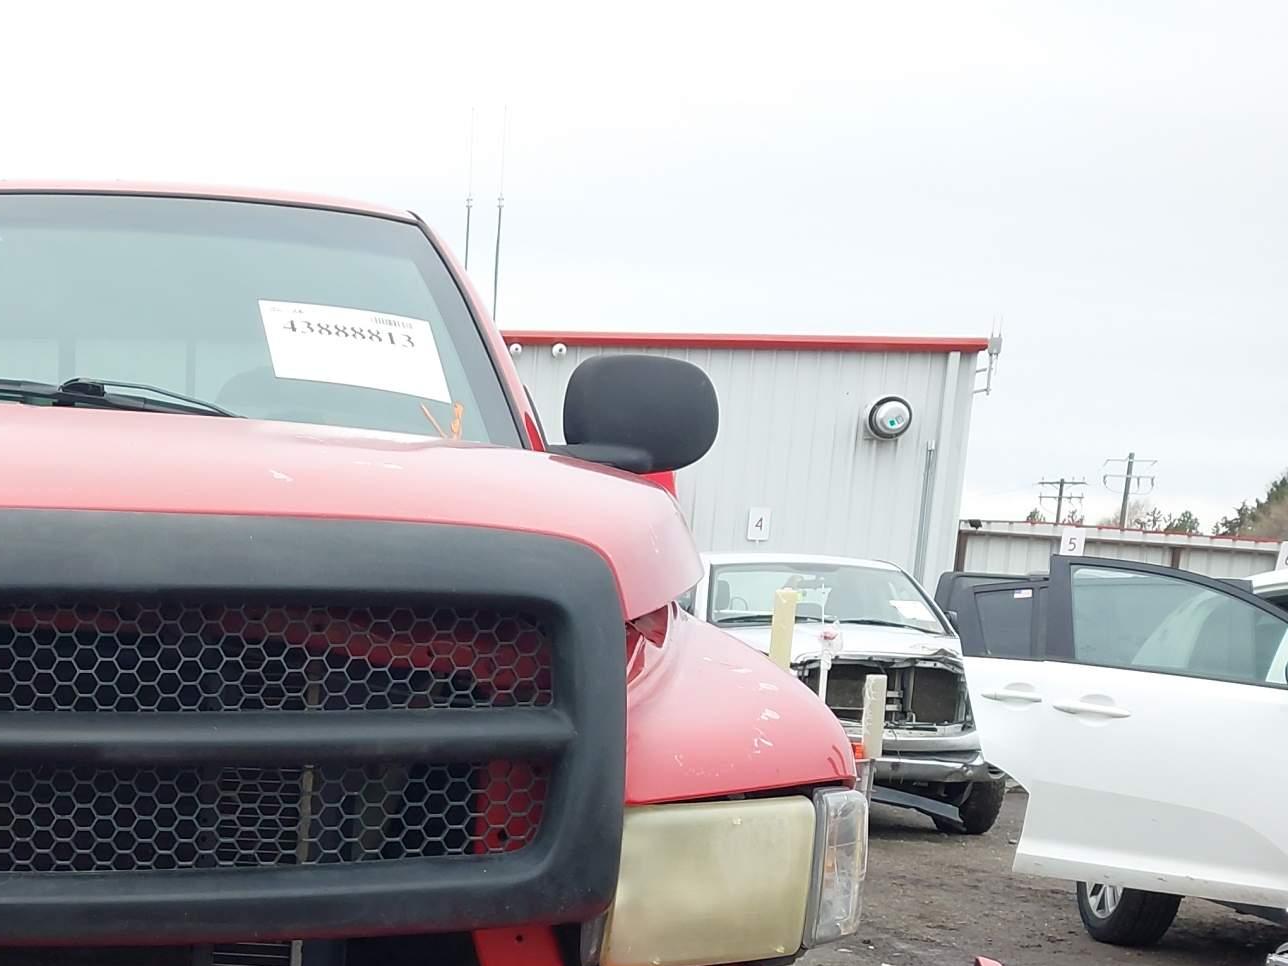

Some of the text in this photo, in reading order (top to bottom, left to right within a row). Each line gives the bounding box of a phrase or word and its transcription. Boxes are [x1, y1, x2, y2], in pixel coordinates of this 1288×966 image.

[282, 319, 415, 349] 43888813
[754, 516, 763, 531] 4
[1067, 537, 1077, 552] 5
